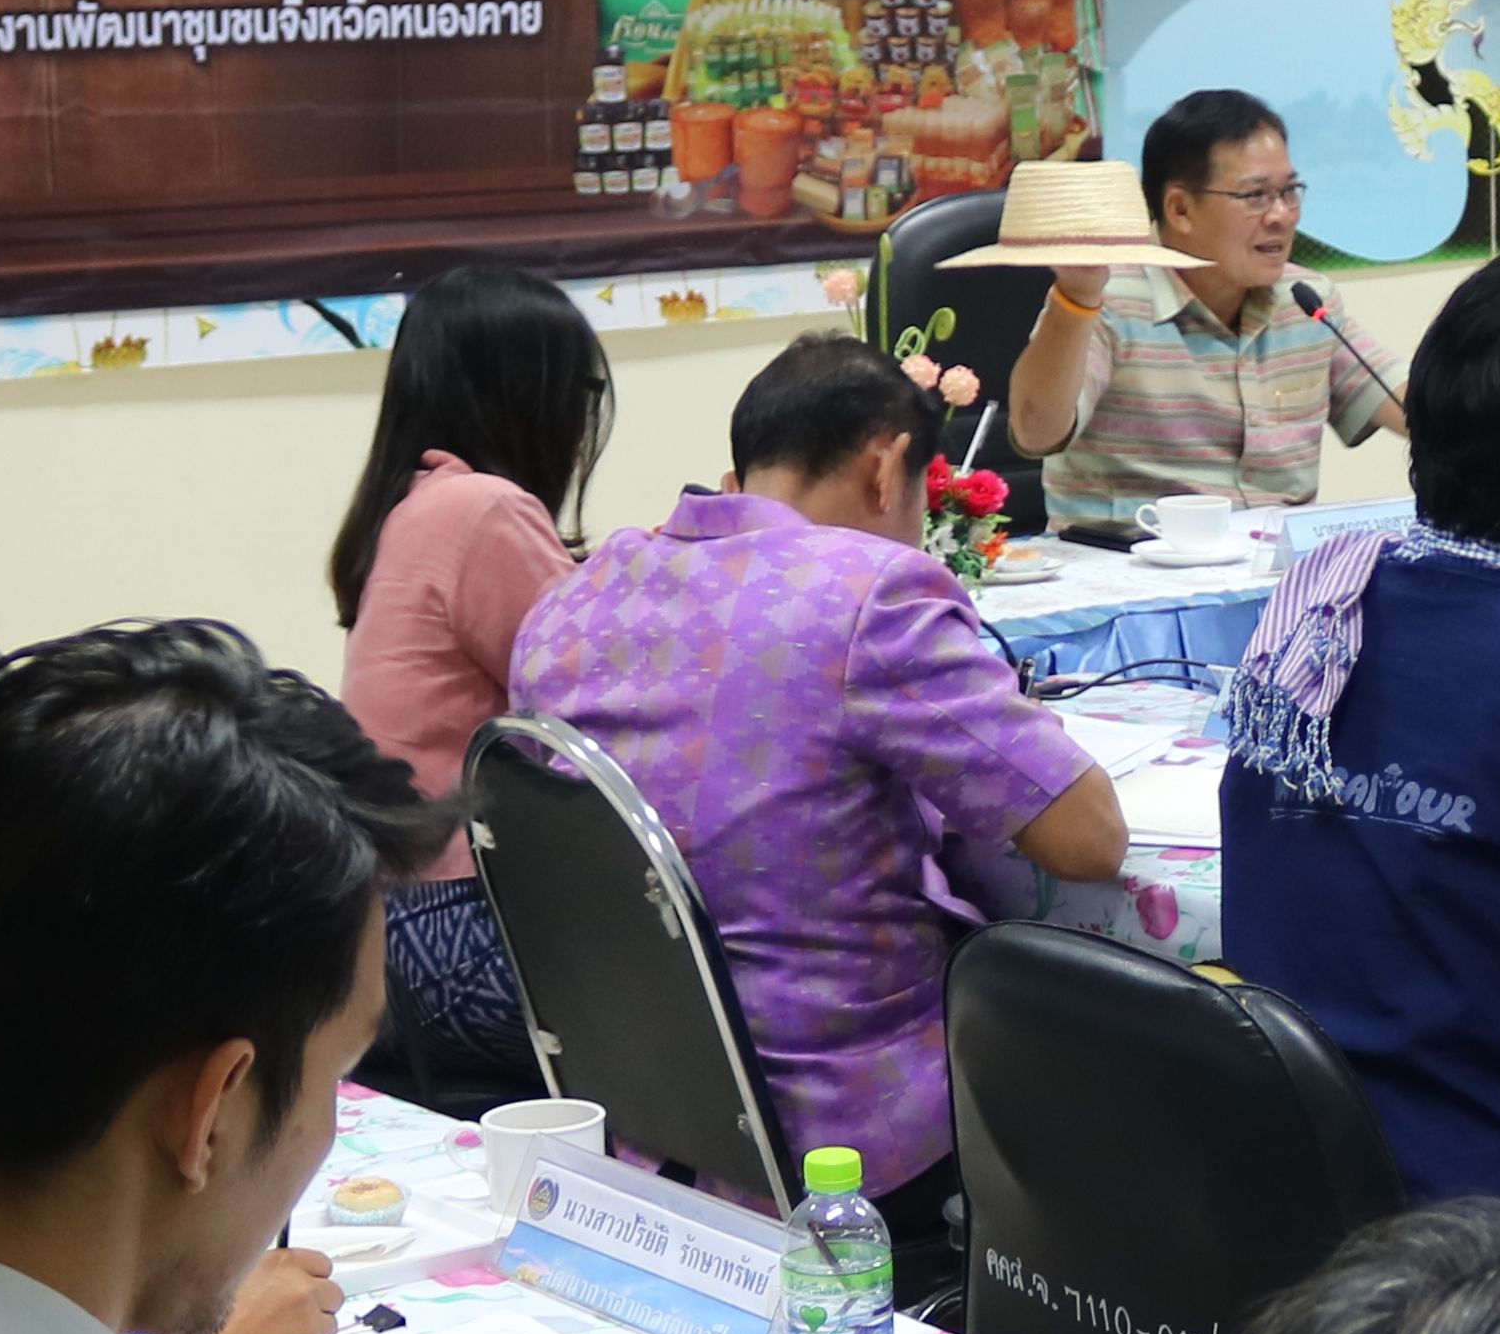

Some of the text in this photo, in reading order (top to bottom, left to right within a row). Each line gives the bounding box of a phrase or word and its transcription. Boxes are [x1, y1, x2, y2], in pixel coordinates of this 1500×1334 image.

[678, 1231, 777, 1296] รักษาทรัพย์
